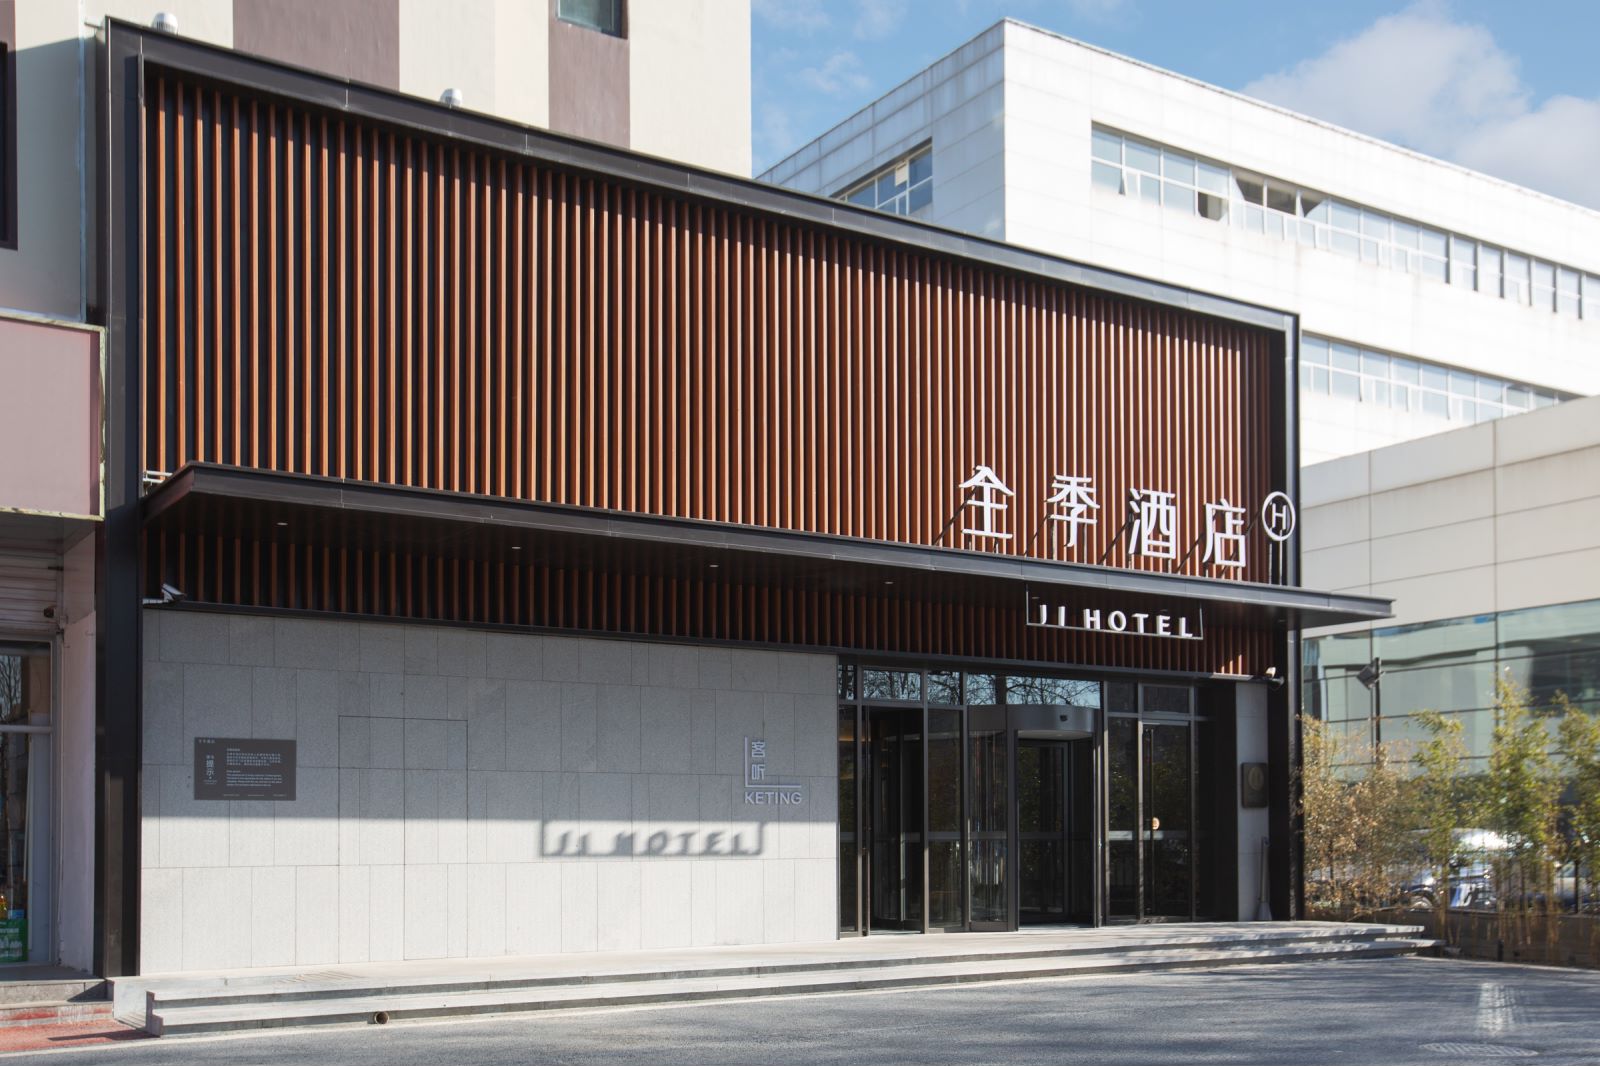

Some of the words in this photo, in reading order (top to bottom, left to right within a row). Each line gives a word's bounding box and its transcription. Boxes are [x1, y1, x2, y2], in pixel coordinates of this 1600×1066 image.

[958, 464, 1247, 568] 全季酒店
[1039, 604, 1066, 627] JI
[1083, 607, 1194, 638] HOTEL
[744, 791, 803, 806] KETING
